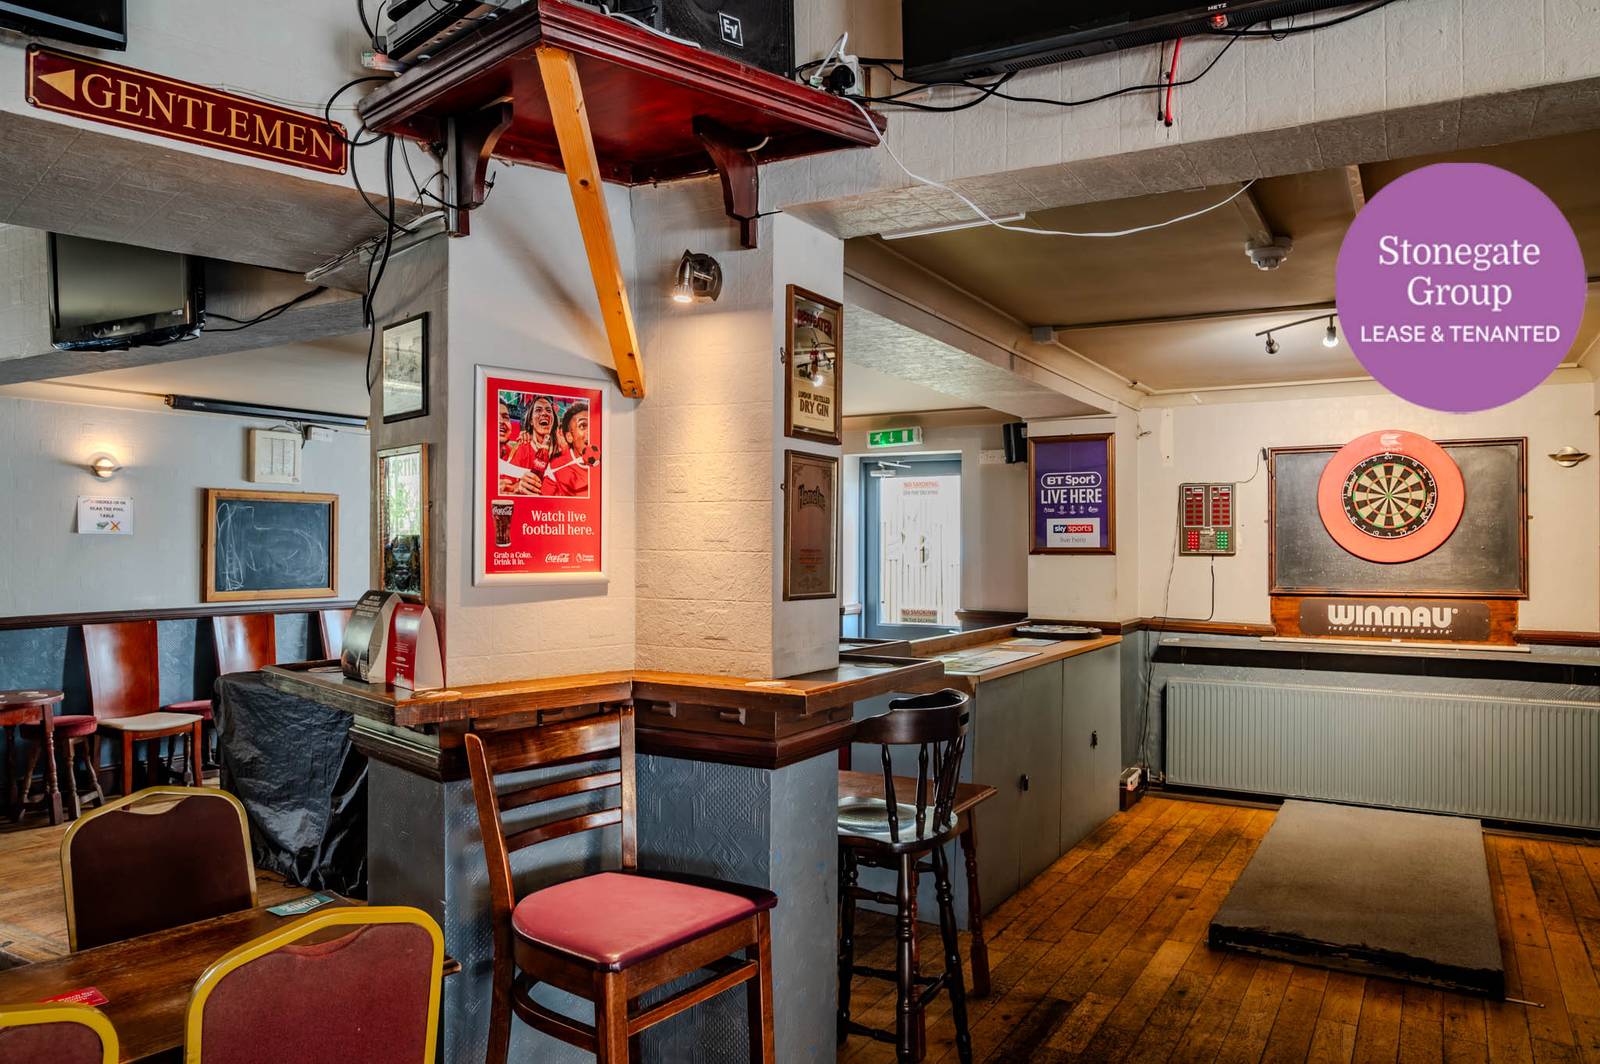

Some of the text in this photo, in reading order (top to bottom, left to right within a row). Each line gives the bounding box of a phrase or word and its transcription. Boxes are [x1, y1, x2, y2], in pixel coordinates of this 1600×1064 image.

[723, 19, 738, 39] EV
[82, 73, 334, 160] GENTLEMEN
[800, 399, 829, 417] DRY GIN
[1047, 475, 1096, 486] BT Sport
[1041, 488, 1102, 504] LIVE HERE
[531, 511, 587, 522] Watch live
[522, 523, 595, 536] football here.
[1054, 525, 1066, 533] sky
